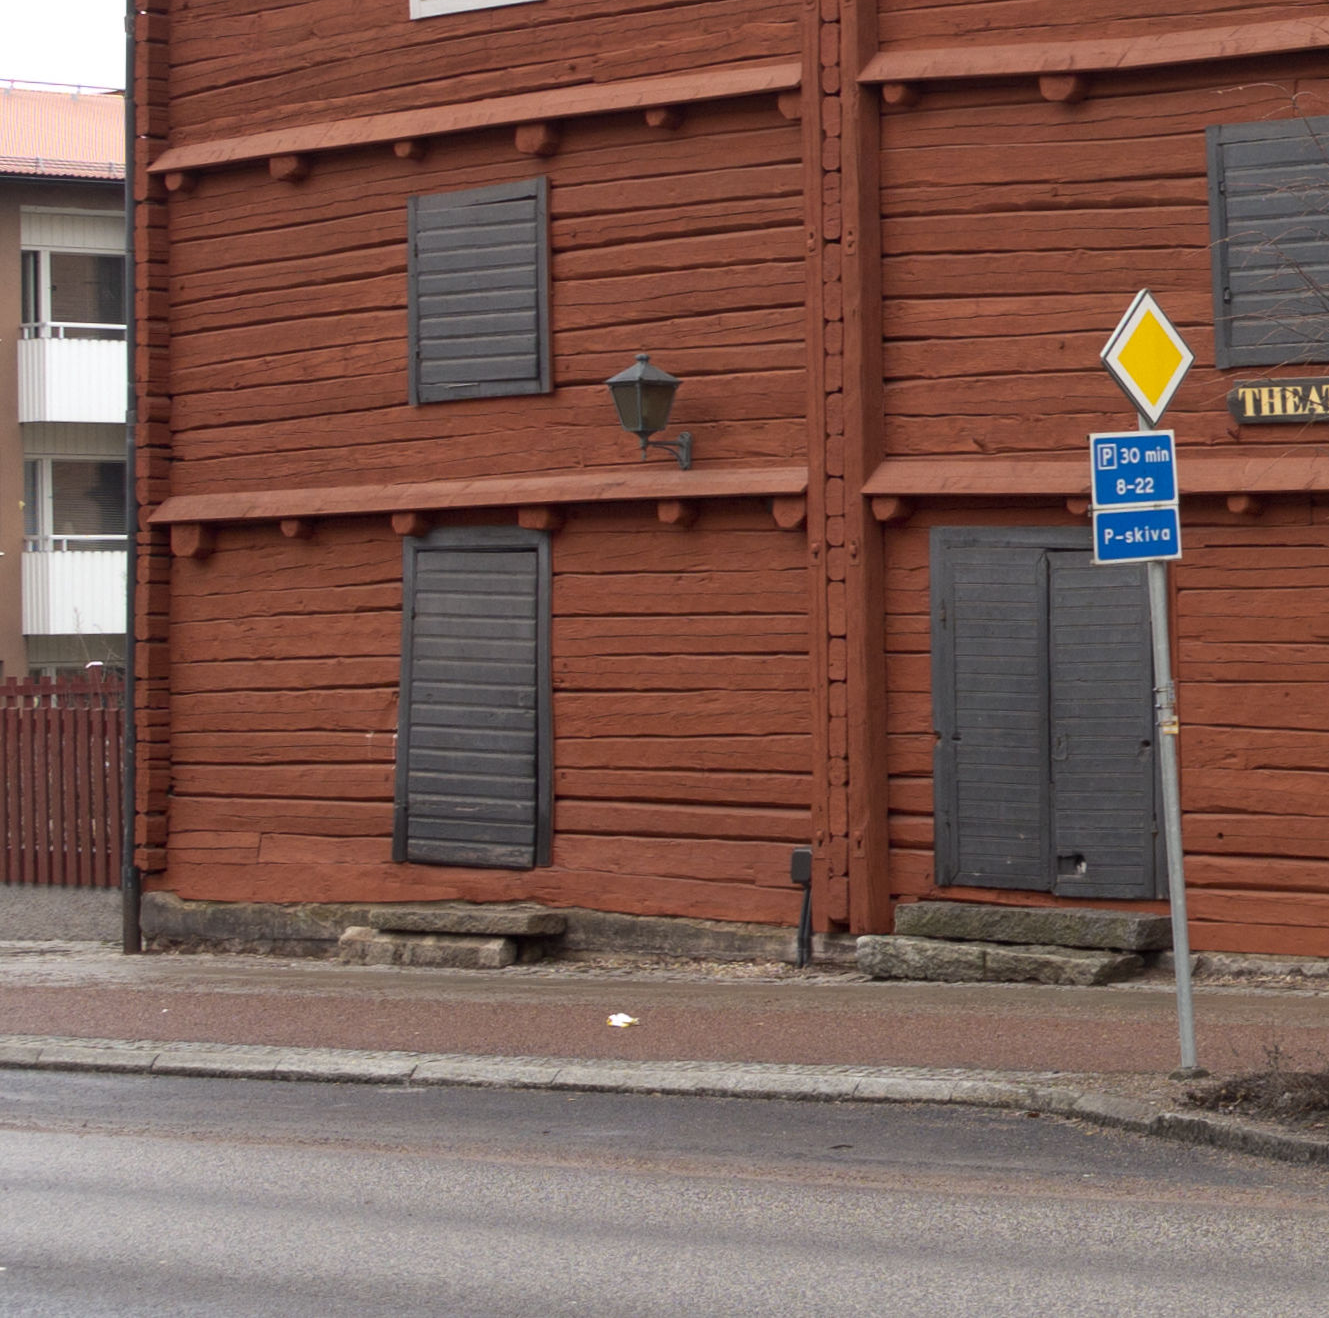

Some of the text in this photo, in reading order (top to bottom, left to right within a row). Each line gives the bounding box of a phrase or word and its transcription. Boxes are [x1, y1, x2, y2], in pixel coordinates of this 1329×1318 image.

[1102, 446, 1170, 466] P 30 min
[1116, 477, 1155, 495] 8-22
[1104, 525, 1171, 545] P-skiva
